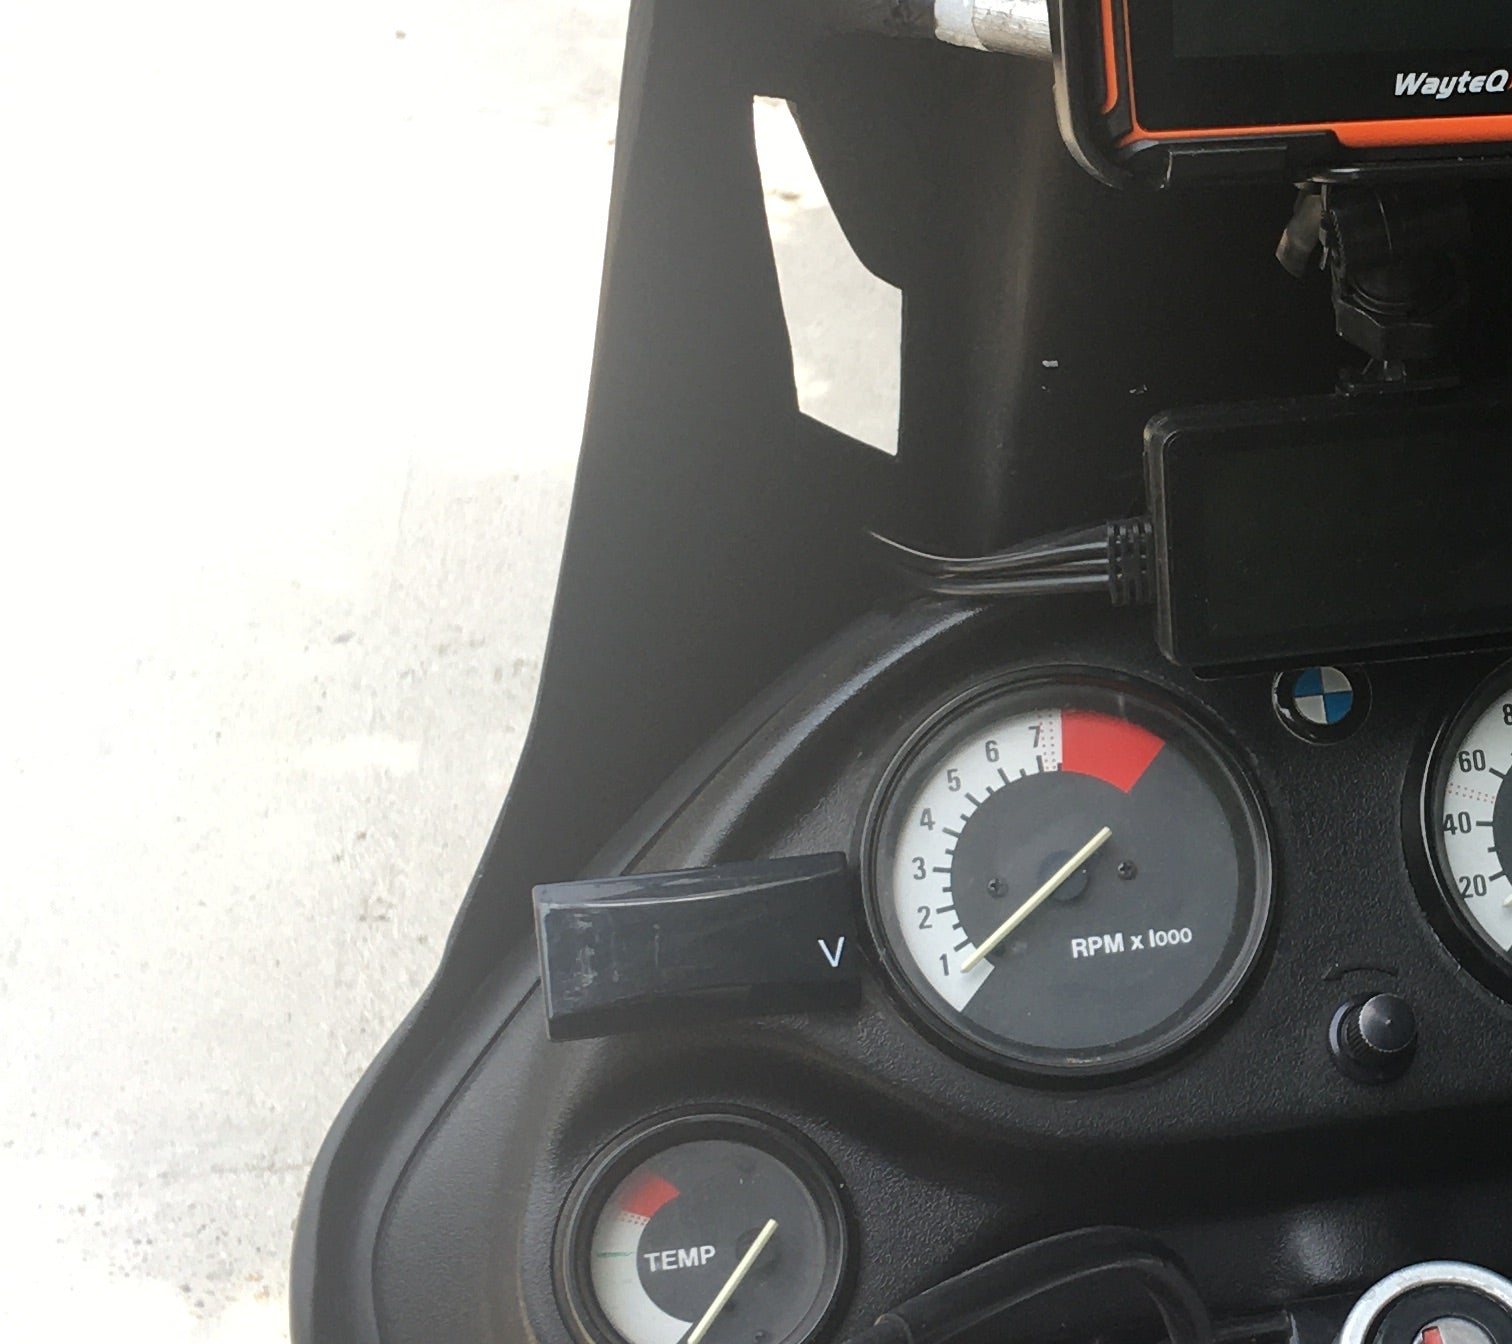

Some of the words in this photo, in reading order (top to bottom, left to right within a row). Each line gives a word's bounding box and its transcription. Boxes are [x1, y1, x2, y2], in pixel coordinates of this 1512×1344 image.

[1394, 69, 1509, 100] WayteQ
[1028, 726, 1042, 748] 7
[985, 740, 1000, 763] 6
[1458, 749, 1486, 773] 60
[947, 768, 962, 792] 5
[920, 807, 935, 831] 4
[1443, 811, 1472, 836] 40
[912, 856, 927, 880] 3
[1458, 874, 1487, 899] 20
[917, 905, 933, 929] 2
[817, 936, 845, 968] V
[1071, 932, 1125, 959] RPM
[1130, 935, 1145, 951] x
[1148, 927, 1193, 948] 1000
[939, 953, 950, 976] 1
[643, 1245, 716, 1272] TEMP
